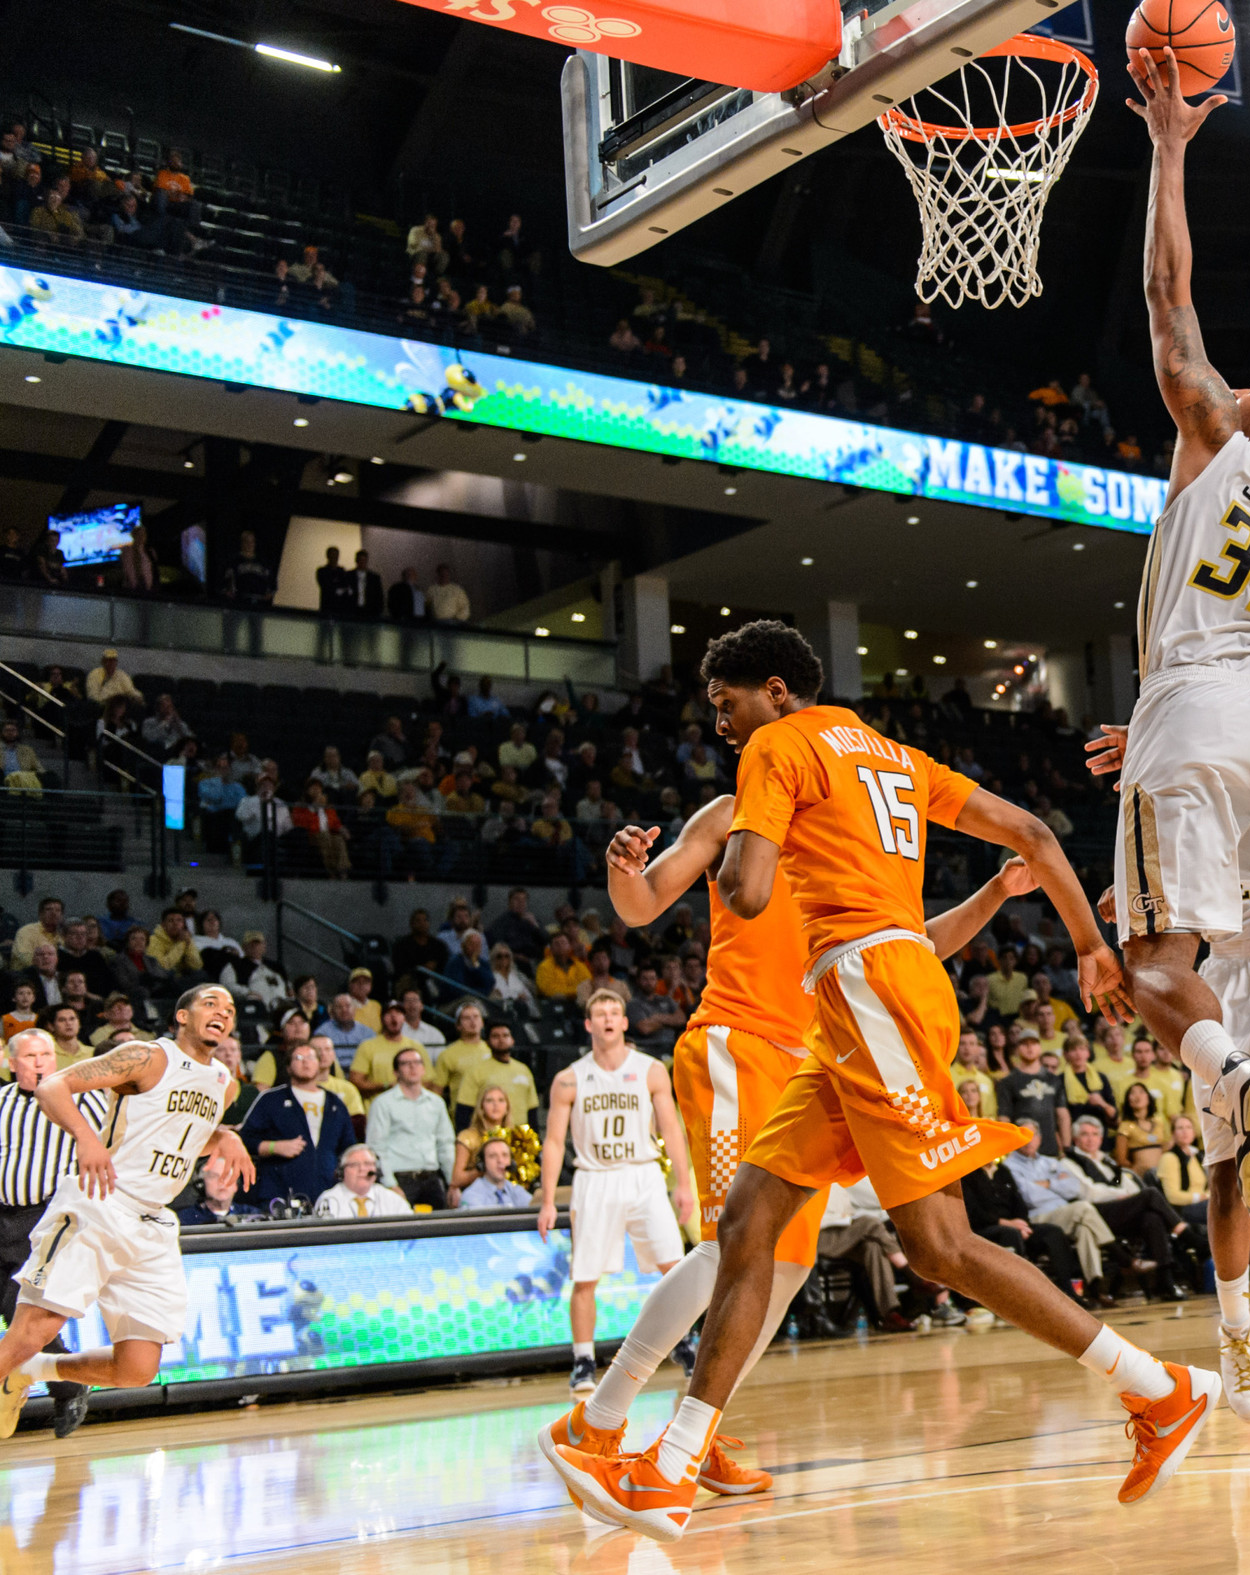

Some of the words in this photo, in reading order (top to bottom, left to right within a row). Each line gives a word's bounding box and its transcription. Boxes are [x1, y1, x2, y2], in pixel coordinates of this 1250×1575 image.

[926, 437, 1049, 505] MAKE
[1081, 467, 1169, 525] SOM
[855, 764, 920, 862] 15
[167, 1090, 218, 1124] GEORGIA
[583, 1092, 639, 1114] GEORGIA
[177, 1122, 194, 1151] 1
[602, 1115, 625, 1138] 10
[592, 1142, 635, 1160] TECH
[919, 1124, 982, 1170] VOLS
[149, 1149, 191, 1181] TECH
